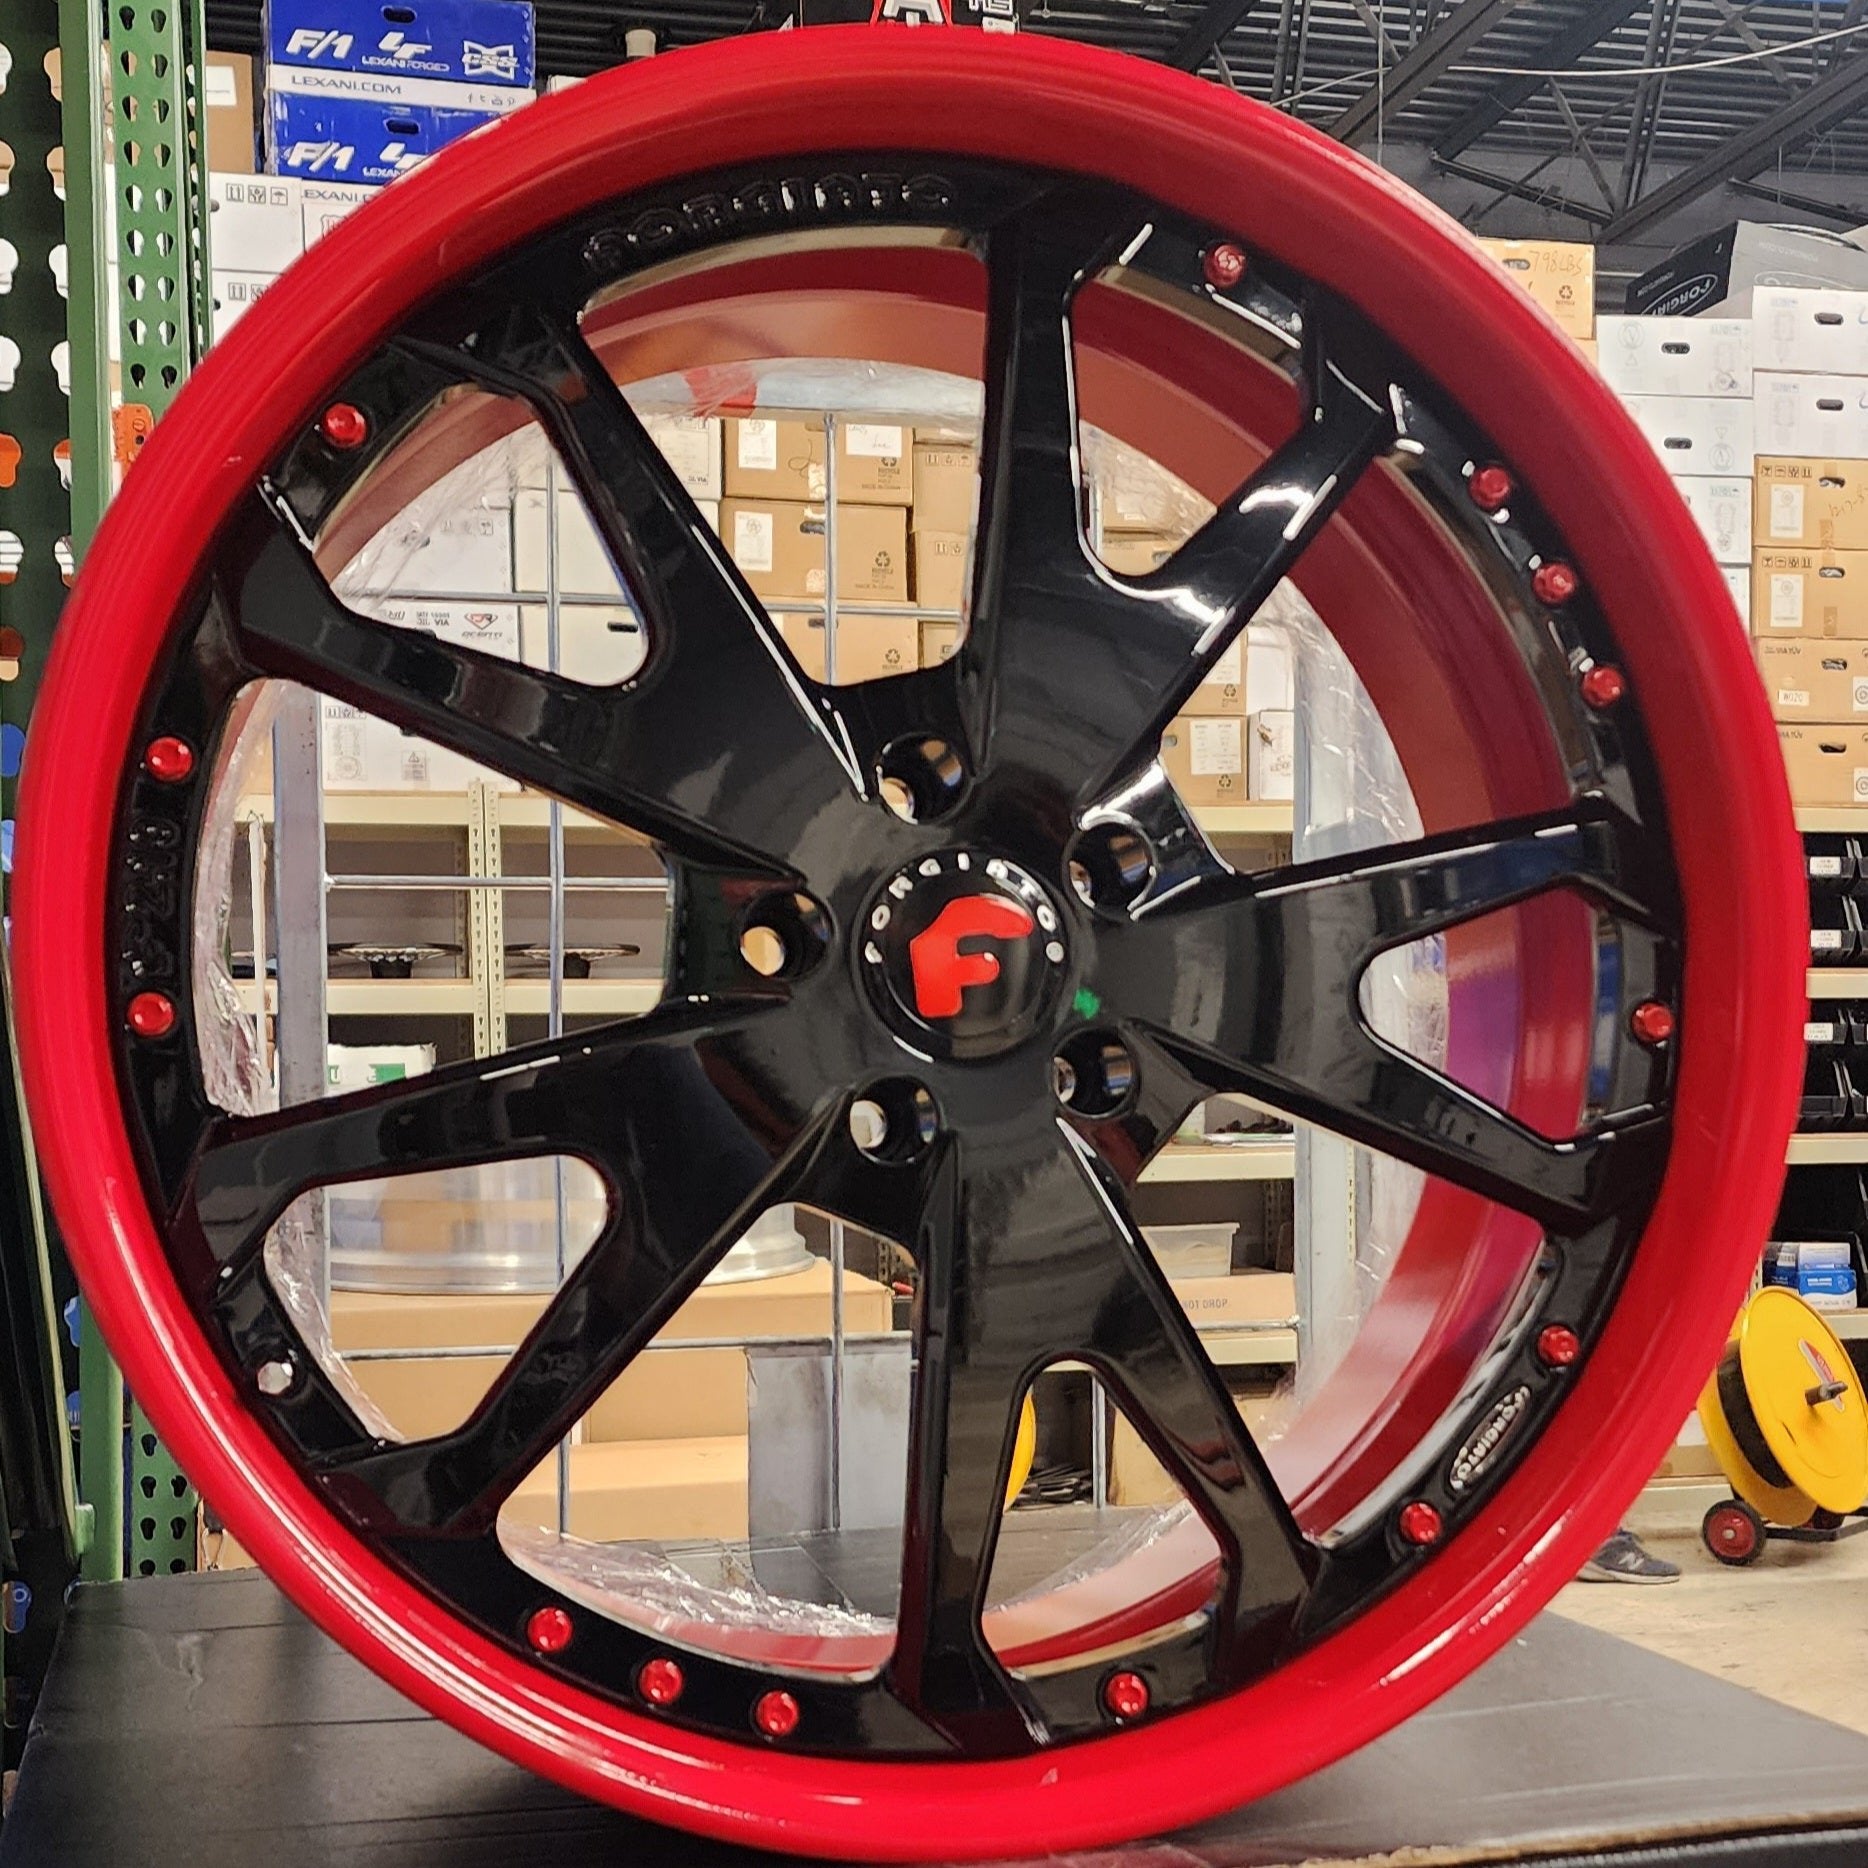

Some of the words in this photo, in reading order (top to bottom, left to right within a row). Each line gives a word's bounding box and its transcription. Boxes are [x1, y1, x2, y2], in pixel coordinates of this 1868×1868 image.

[362, 55, 405, 69] LEXANI
[406, 60, 450, 72] FORGED
[291, 75, 402, 95] LEXANI.COM
